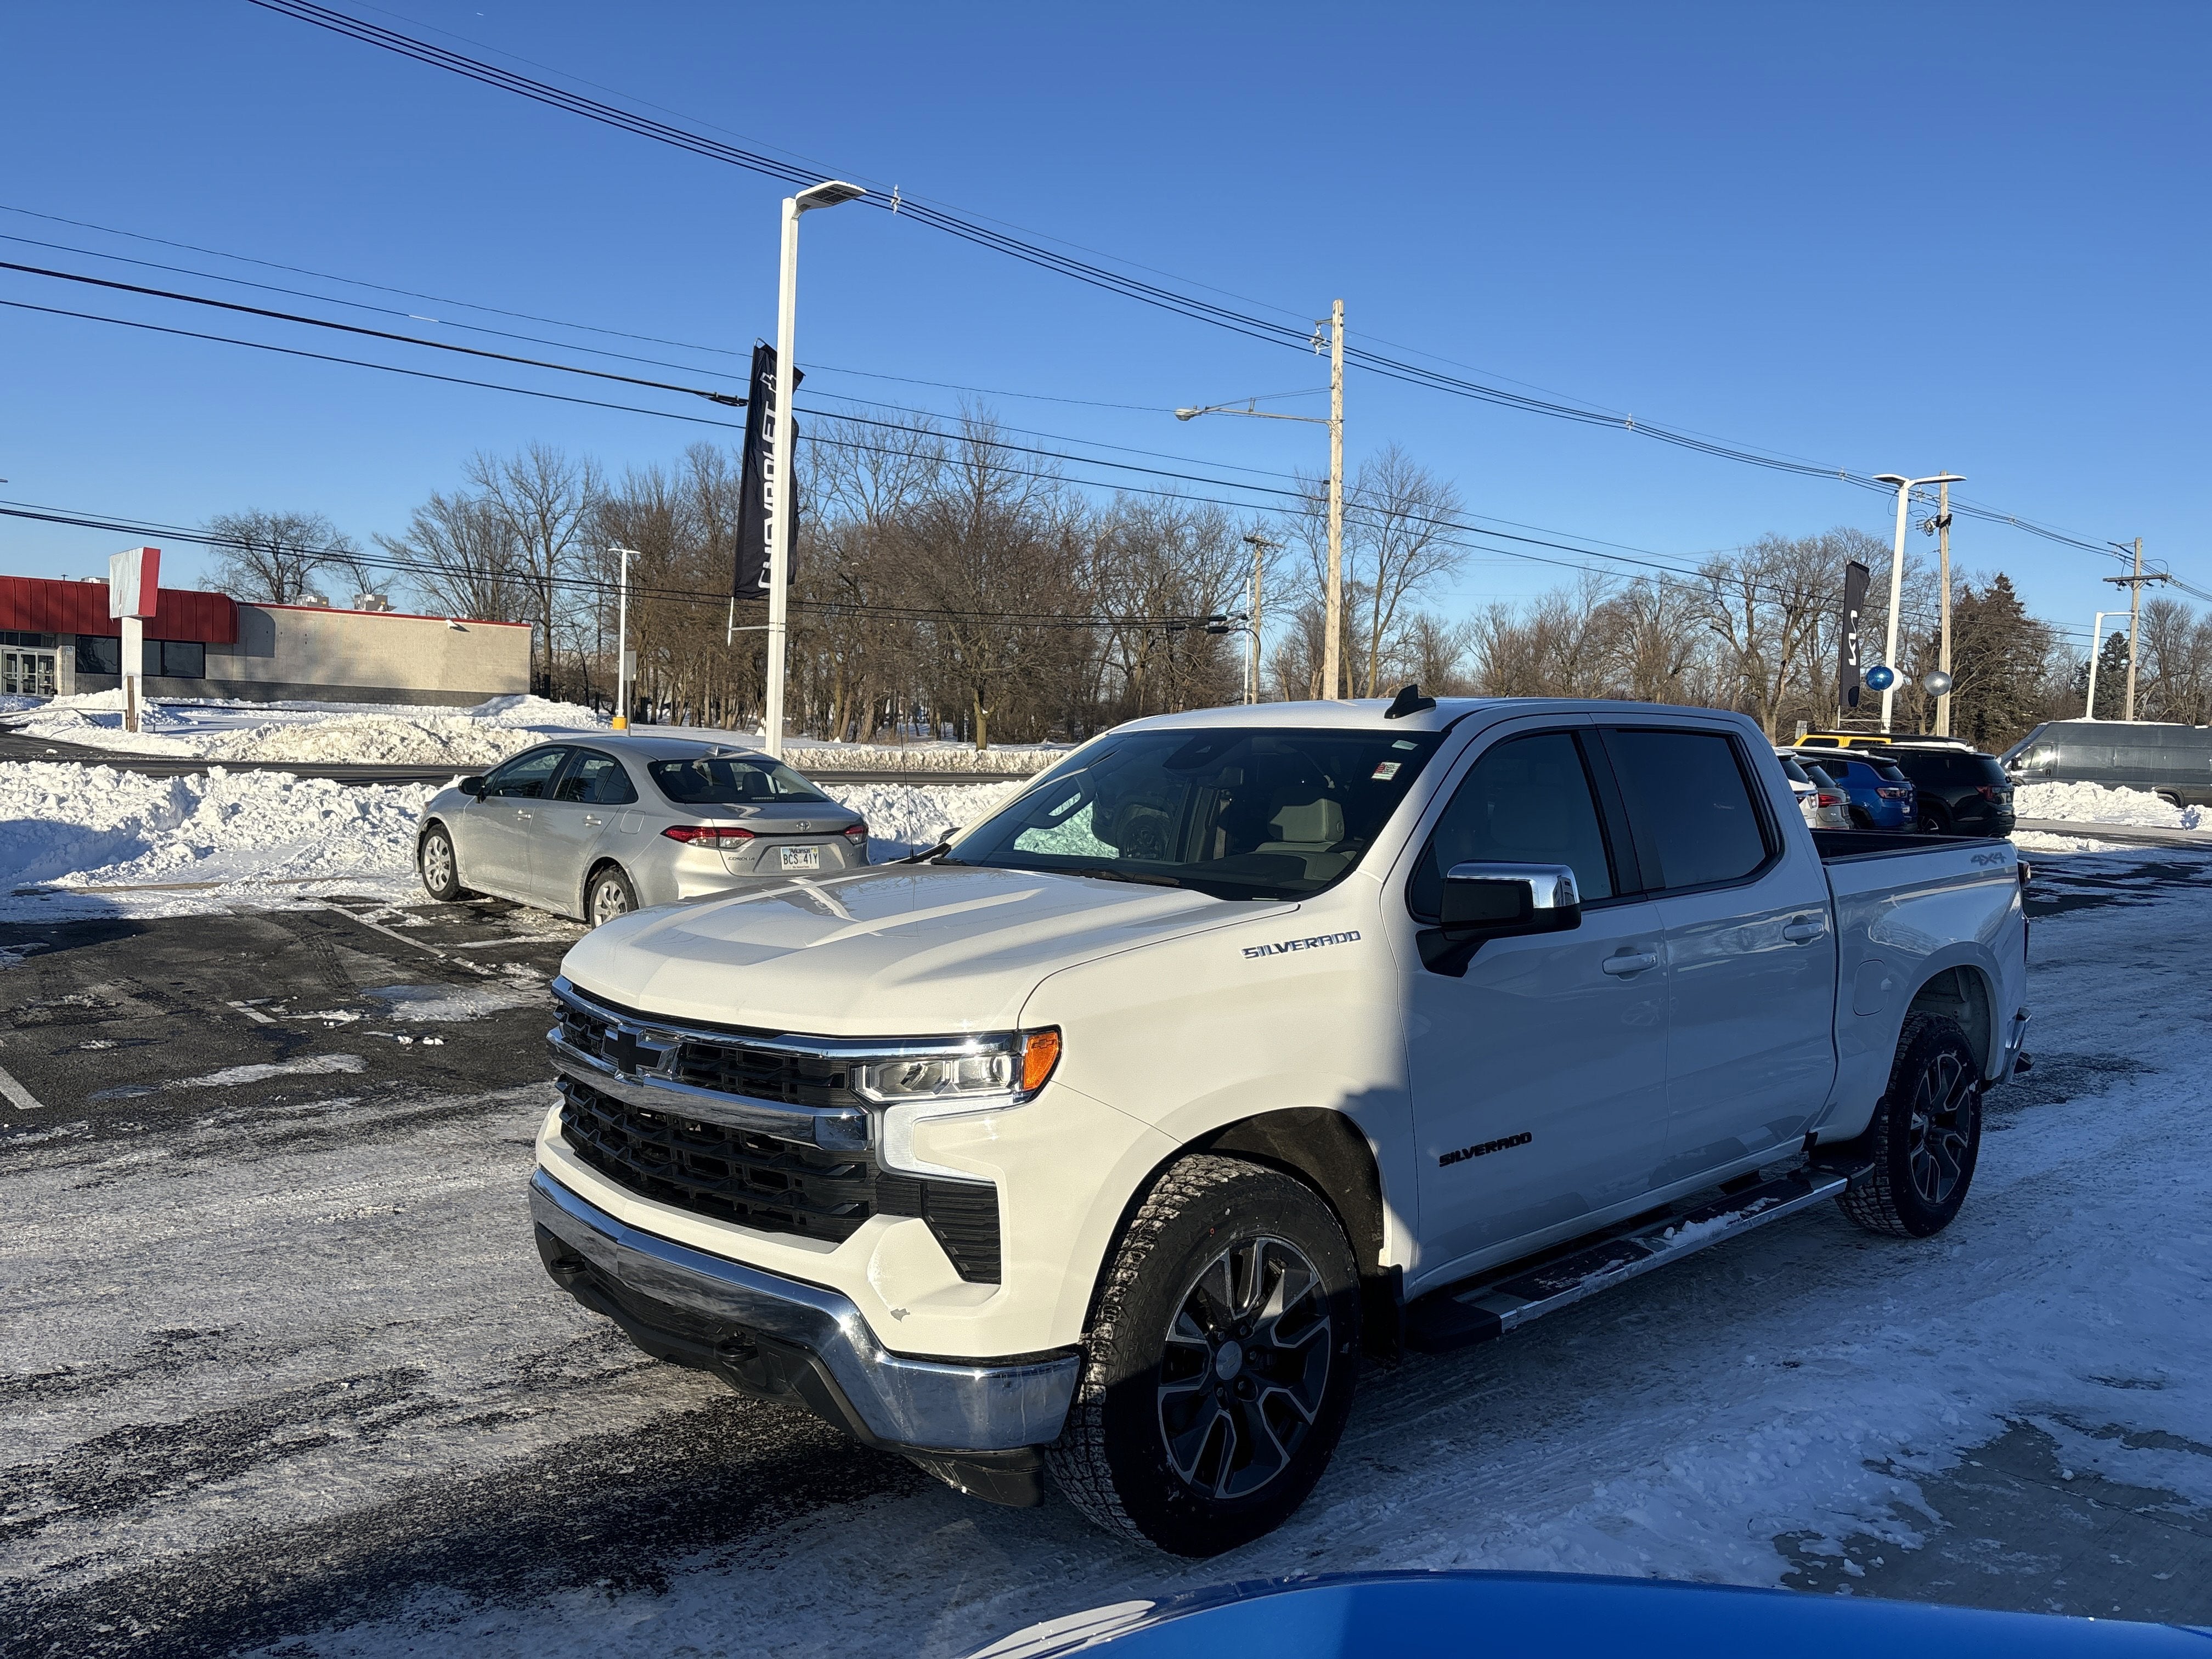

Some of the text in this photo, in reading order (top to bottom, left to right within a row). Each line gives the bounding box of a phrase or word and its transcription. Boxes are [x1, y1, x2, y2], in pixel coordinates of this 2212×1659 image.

[783, 853, 817, 865] BCS 41Y
[1241, 930, 1362, 960] SILVERADO
[1439, 1132, 1532, 1167] SILVERADO
